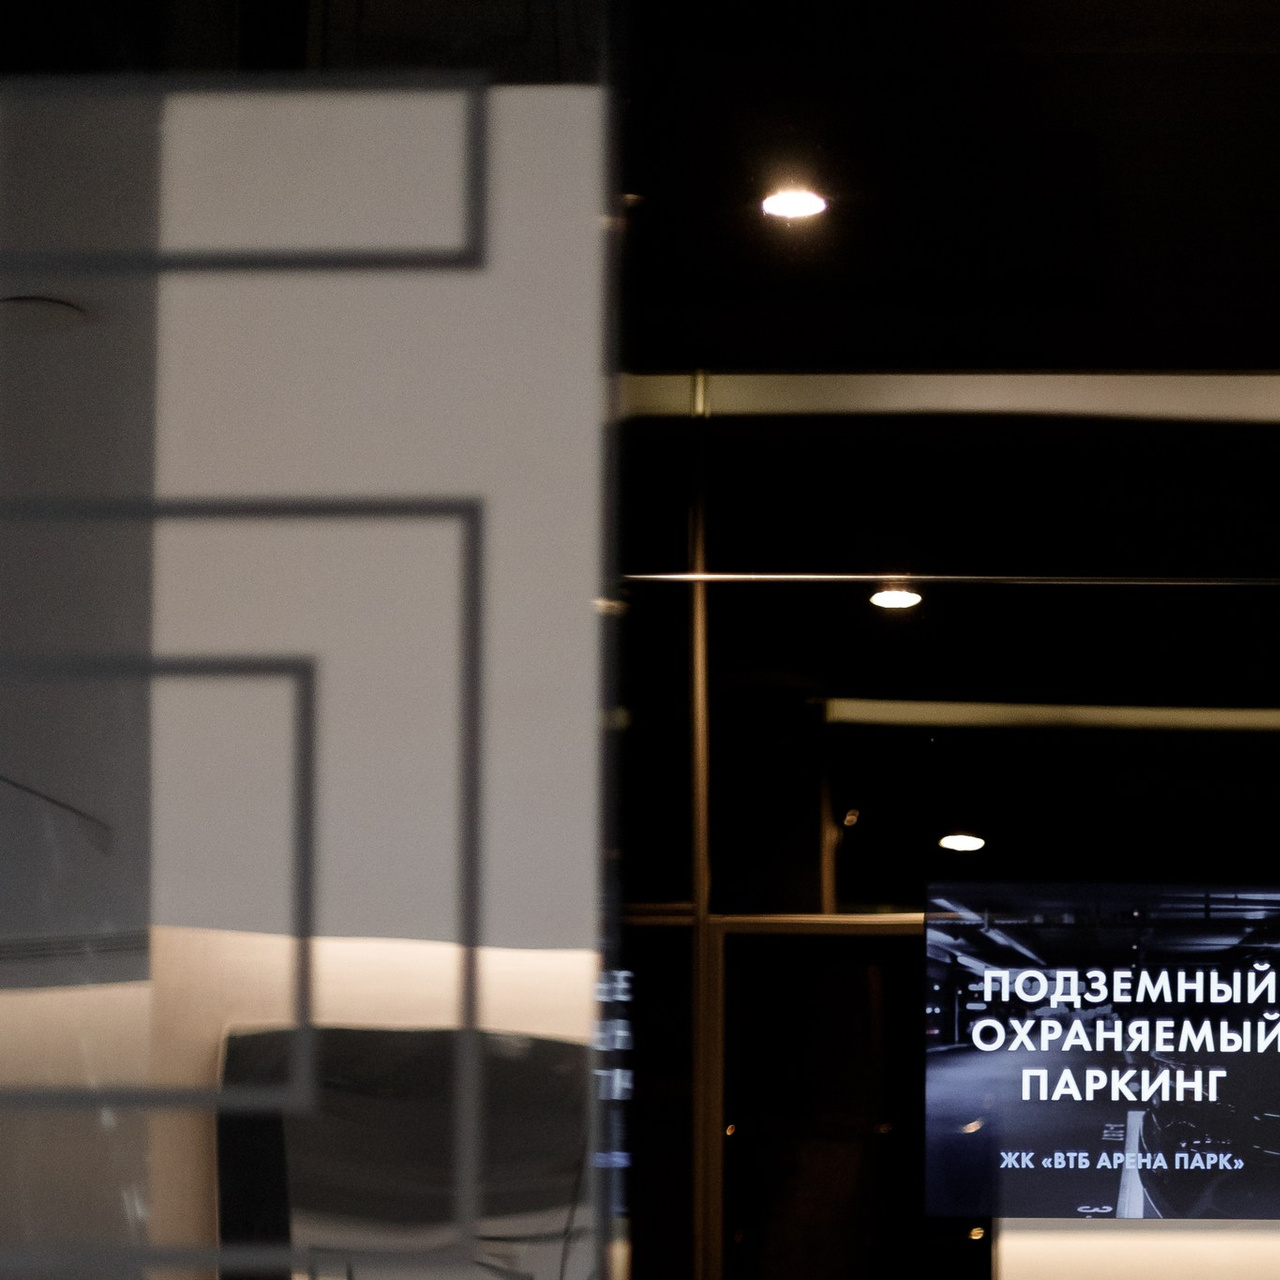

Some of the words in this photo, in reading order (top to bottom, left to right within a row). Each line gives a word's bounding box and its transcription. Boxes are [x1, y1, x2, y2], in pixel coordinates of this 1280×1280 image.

[983, 963, 1276, 1008] ПОДЗЕМНЫЙ
[1022, 1068, 1227, 1101] ПАРКИНГ
[1000, 1152, 1035, 1168] ЖК
[1041, 1152, 1090, 1169] «ВТБ
[1096, 1153, 1168, 1169] АРЕНА
[1175, 1153, 1244, 1170] ПАРК»
